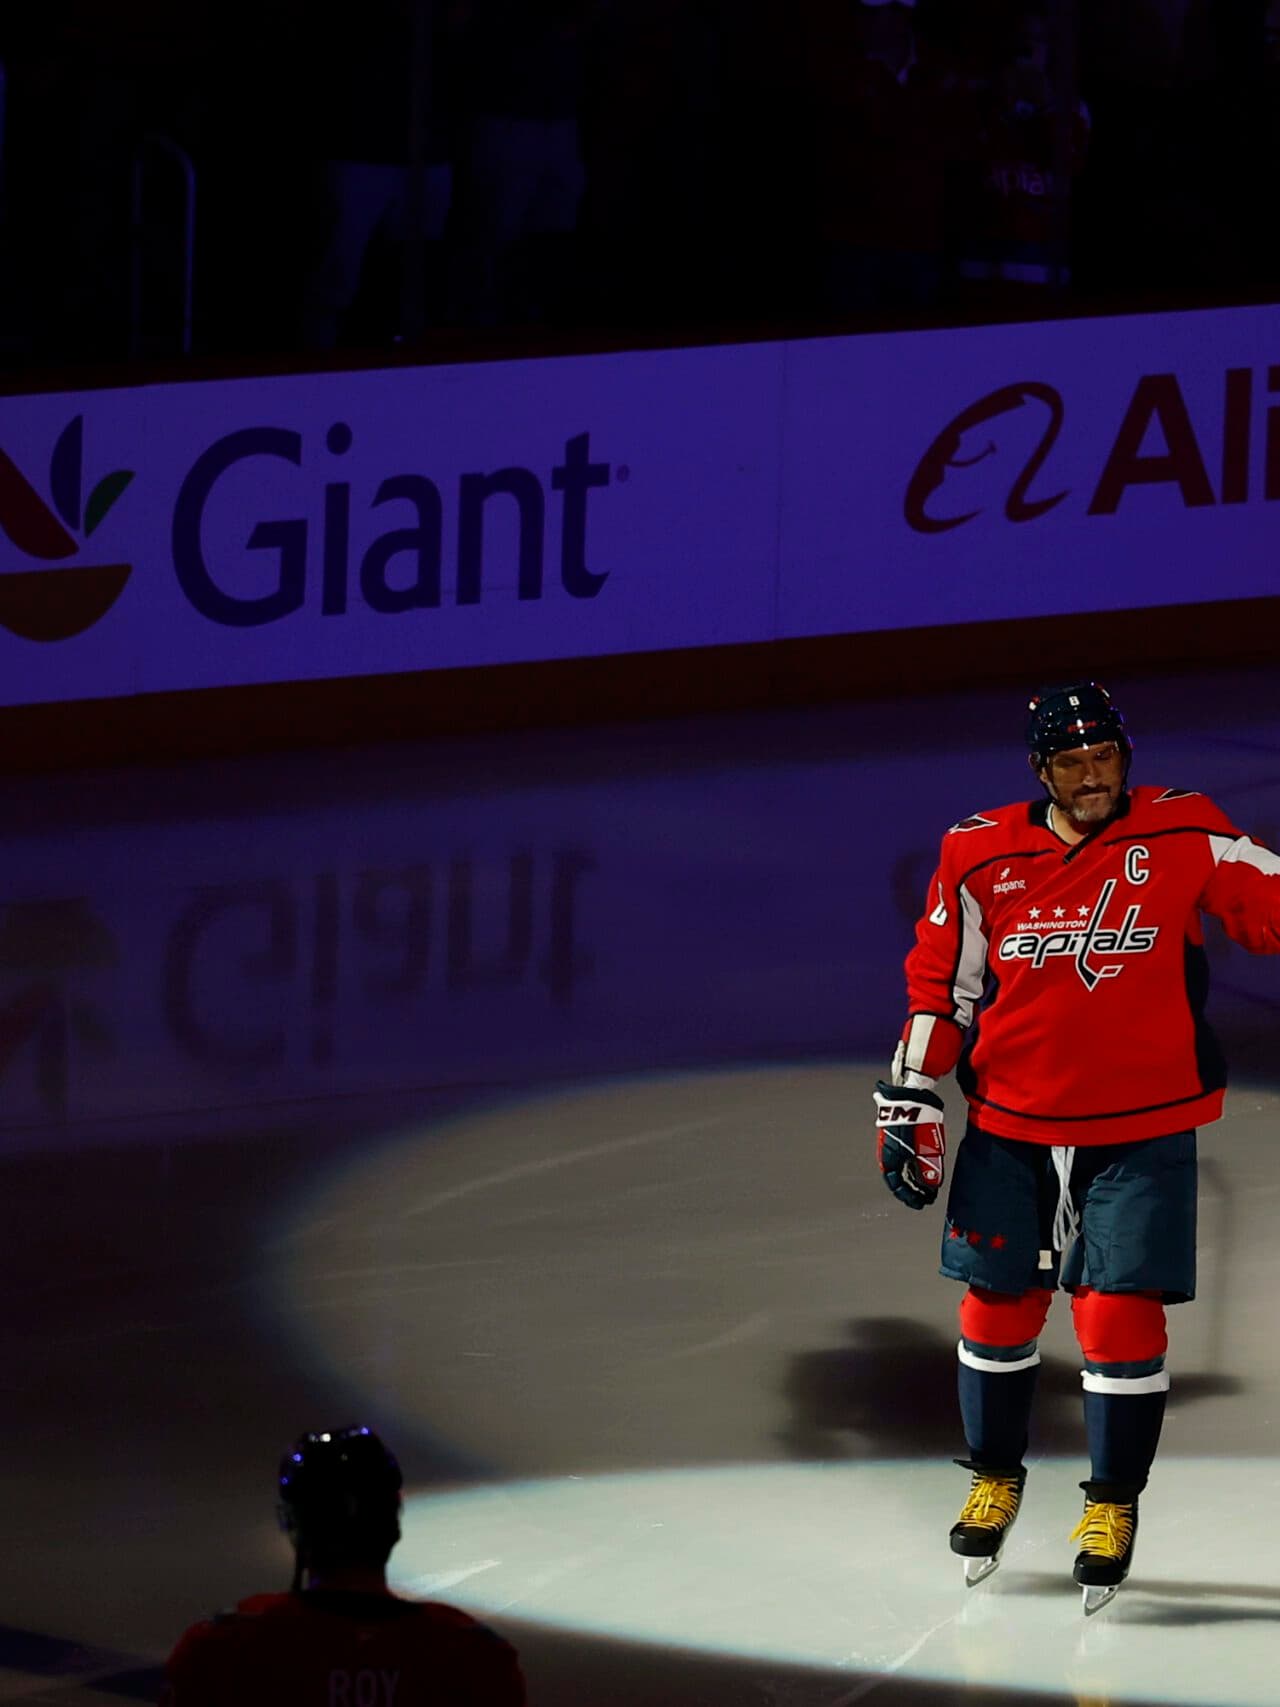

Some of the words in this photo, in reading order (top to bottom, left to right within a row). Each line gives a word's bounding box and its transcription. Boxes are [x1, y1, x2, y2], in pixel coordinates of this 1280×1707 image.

[173, 423, 610, 627] Giant
[1125, 845, 1149, 885] C
[1017, 919, 1088, 931] WASHINGTON
[328, 1669, 401, 1707] ROY
